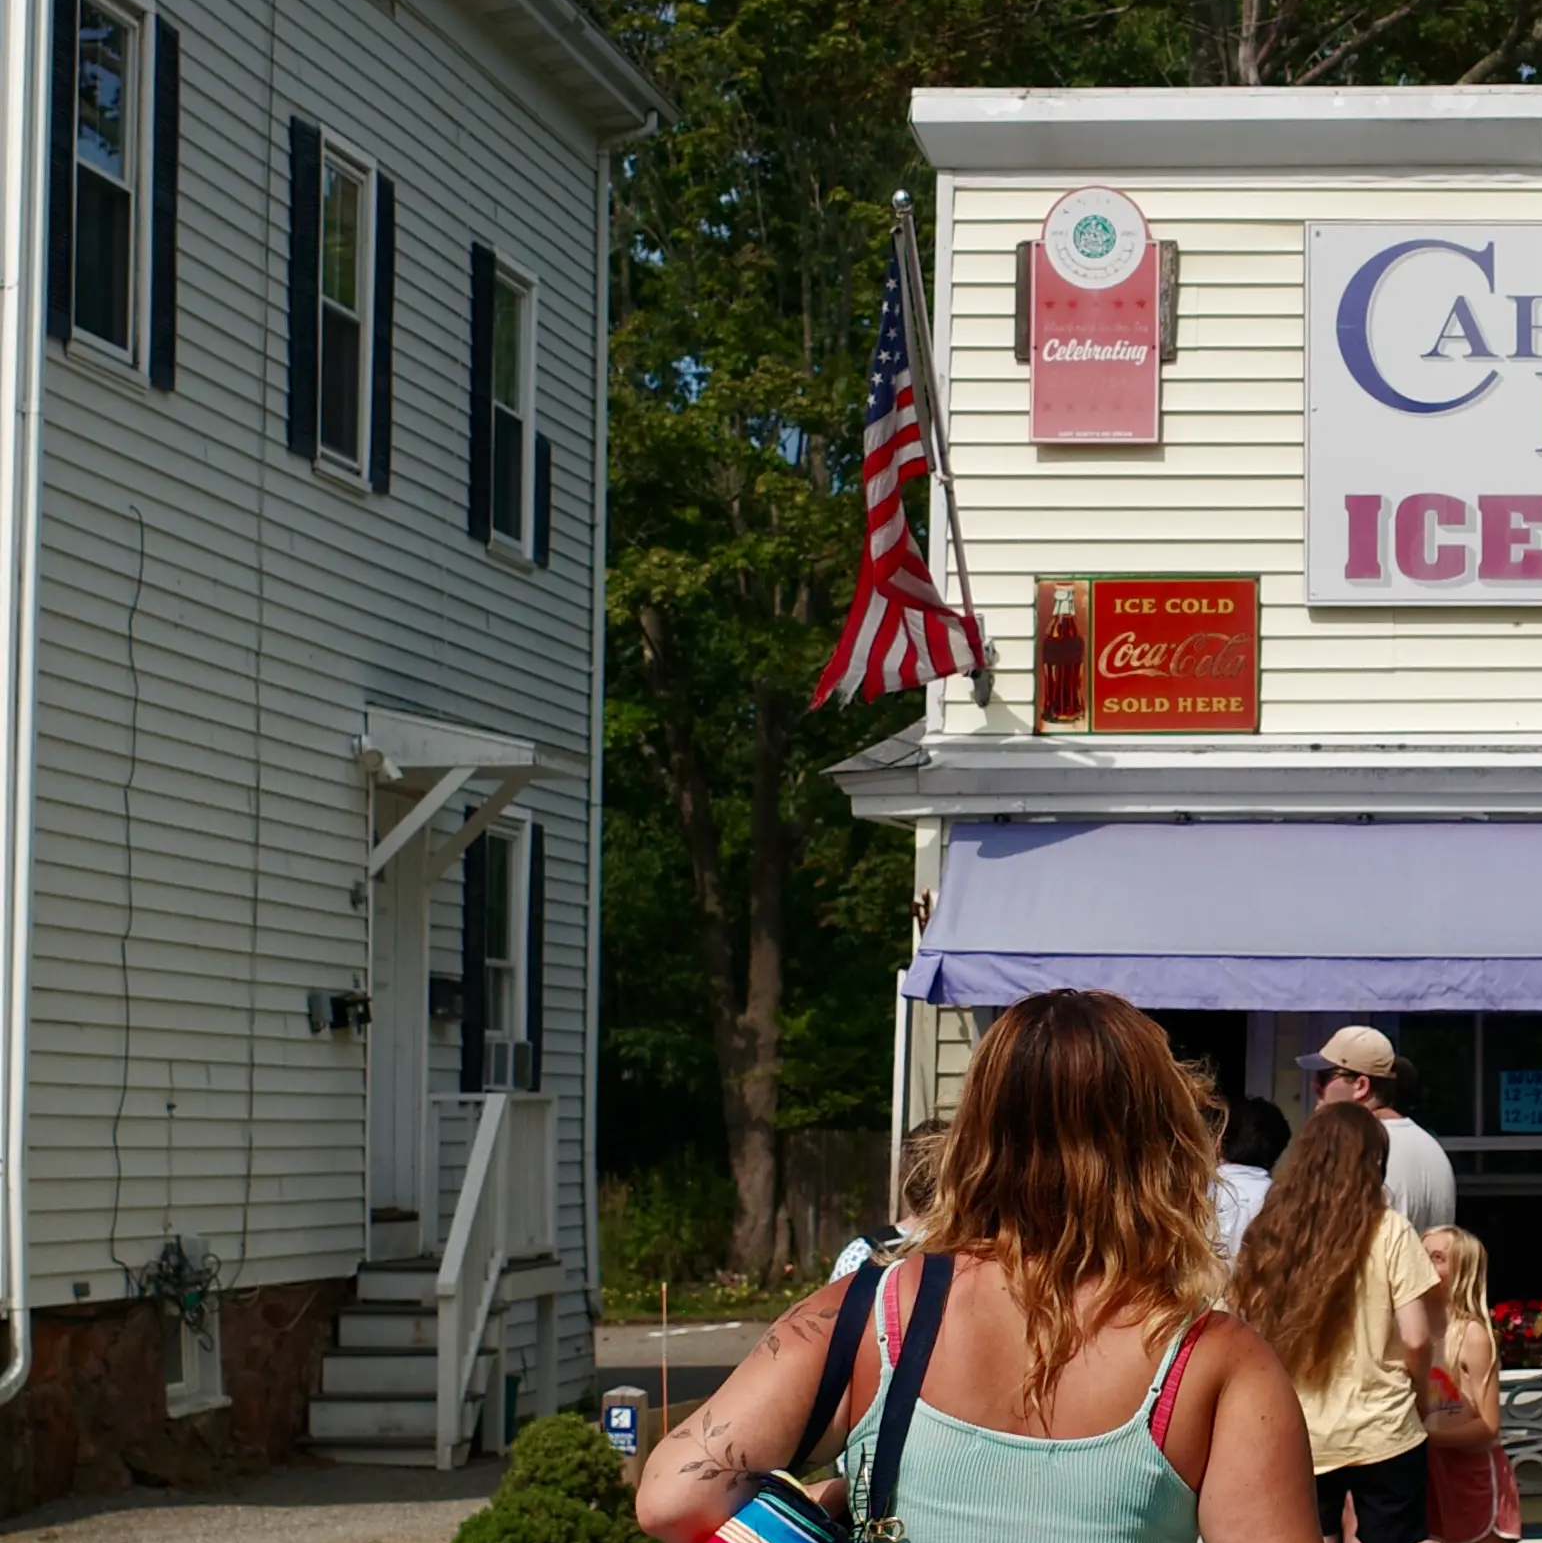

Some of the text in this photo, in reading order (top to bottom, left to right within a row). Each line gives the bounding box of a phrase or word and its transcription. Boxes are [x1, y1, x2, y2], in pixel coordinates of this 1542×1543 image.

[1042, 338, 1149, 366] Celebrating
[1114, 598, 1235, 614] ICE COLD
[1102, 697, 1244, 713] SOLD HERE
